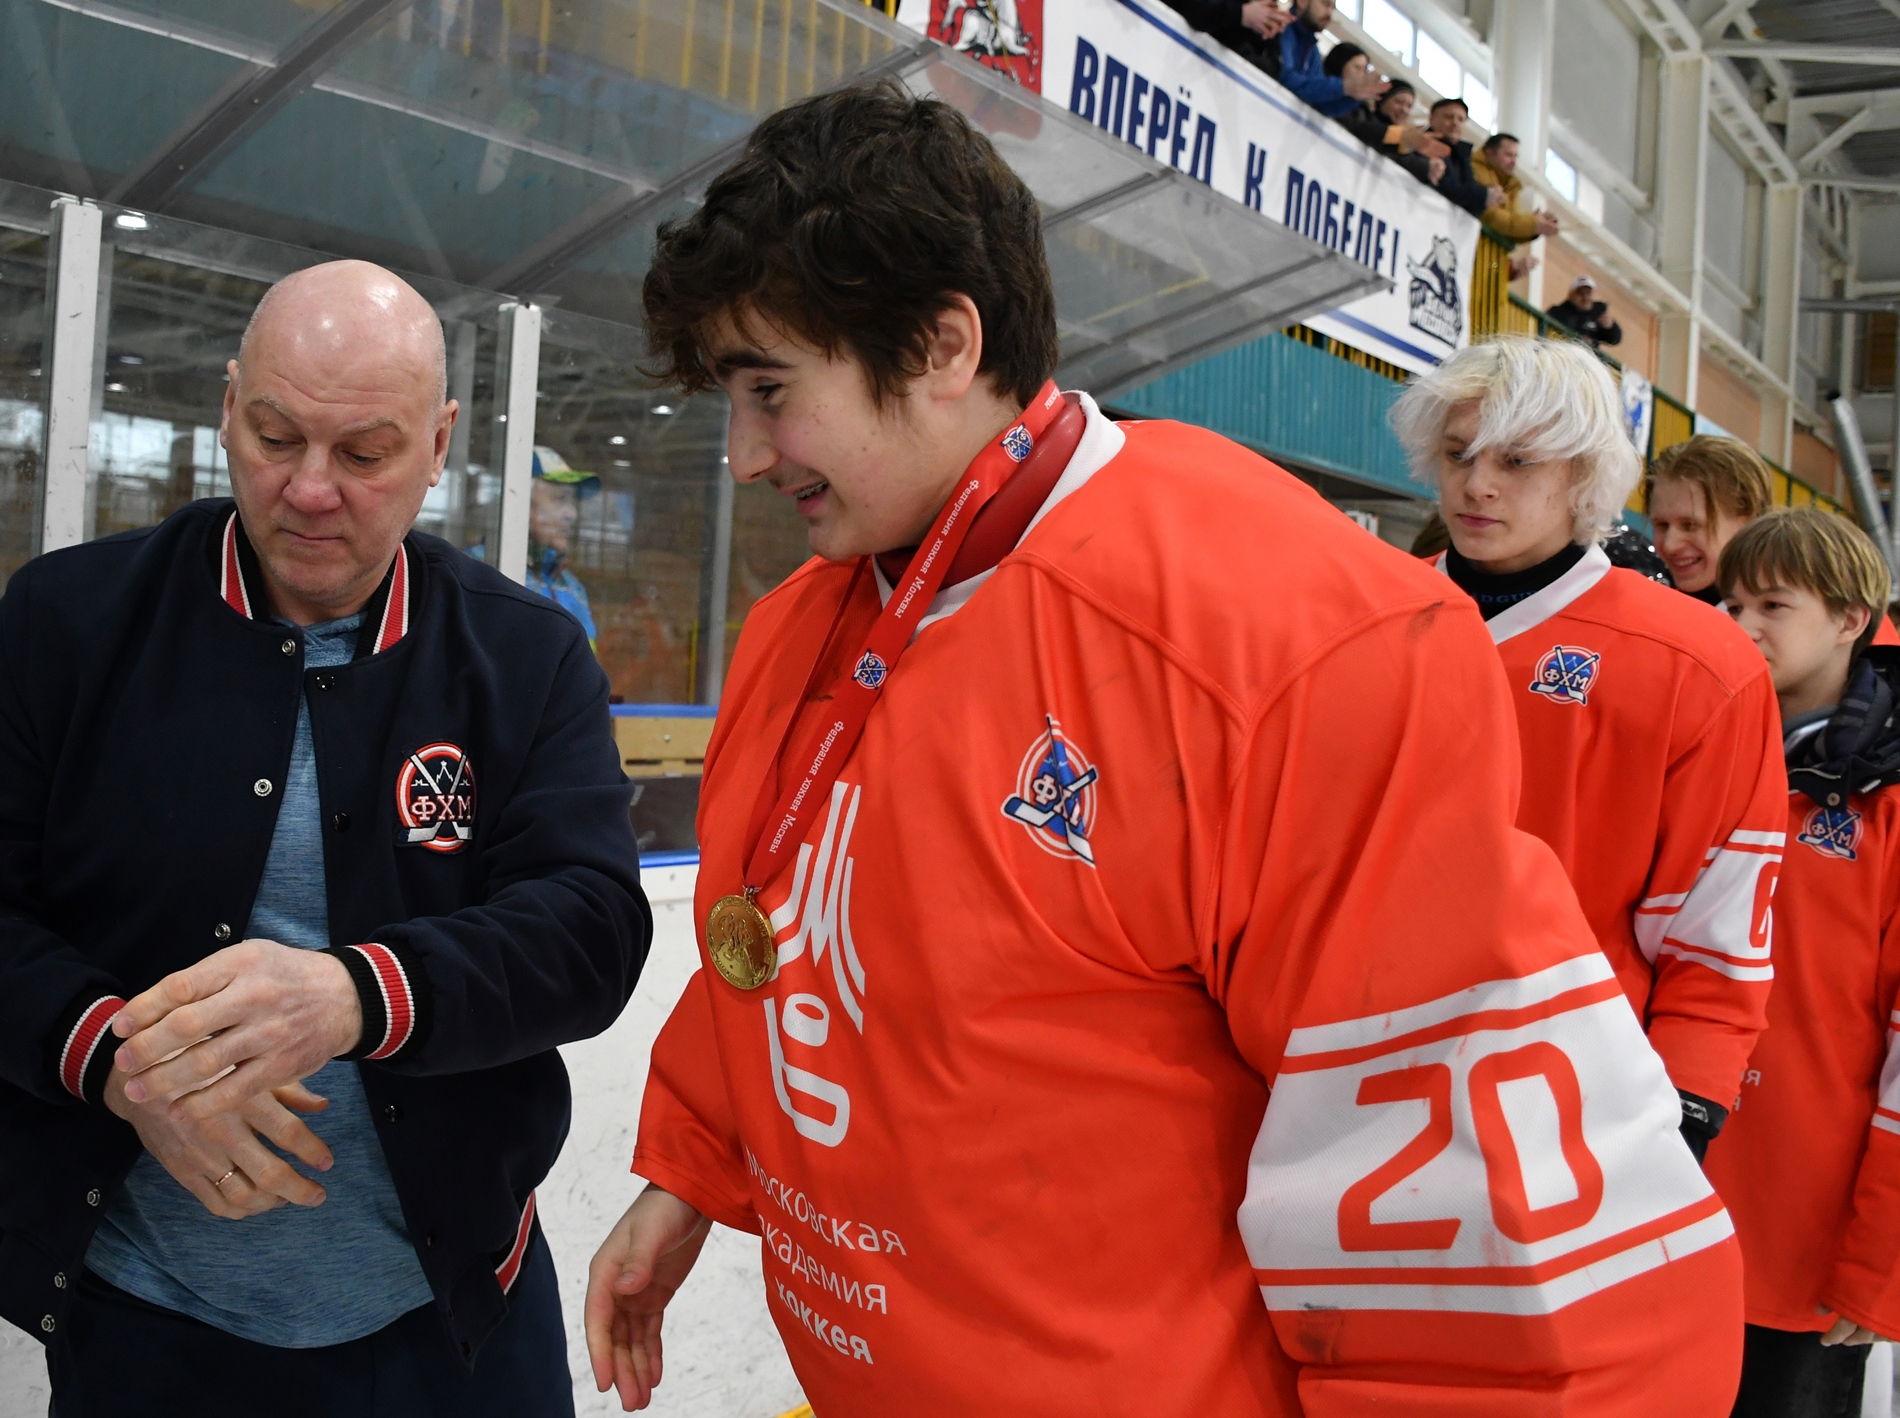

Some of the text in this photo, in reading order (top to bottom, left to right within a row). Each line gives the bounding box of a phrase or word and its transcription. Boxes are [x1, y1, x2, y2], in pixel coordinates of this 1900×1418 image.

[1244, 141, 1267, 213] К
[895, 479, 979, 618] Федерация хоккея Москвы
[1544, 668, 1589, 690] ФХМ
[411, 795, 471, 821] ФХМ
[769, 720, 845, 853] Федерация хоккея Москвы
[1811, 822, 1852, 847] ФХМ
[1338, 1041, 1604, 1252] 20
[745, 1144, 907, 1256] Московская
[775, 1275, 874, 1365] хоккея
